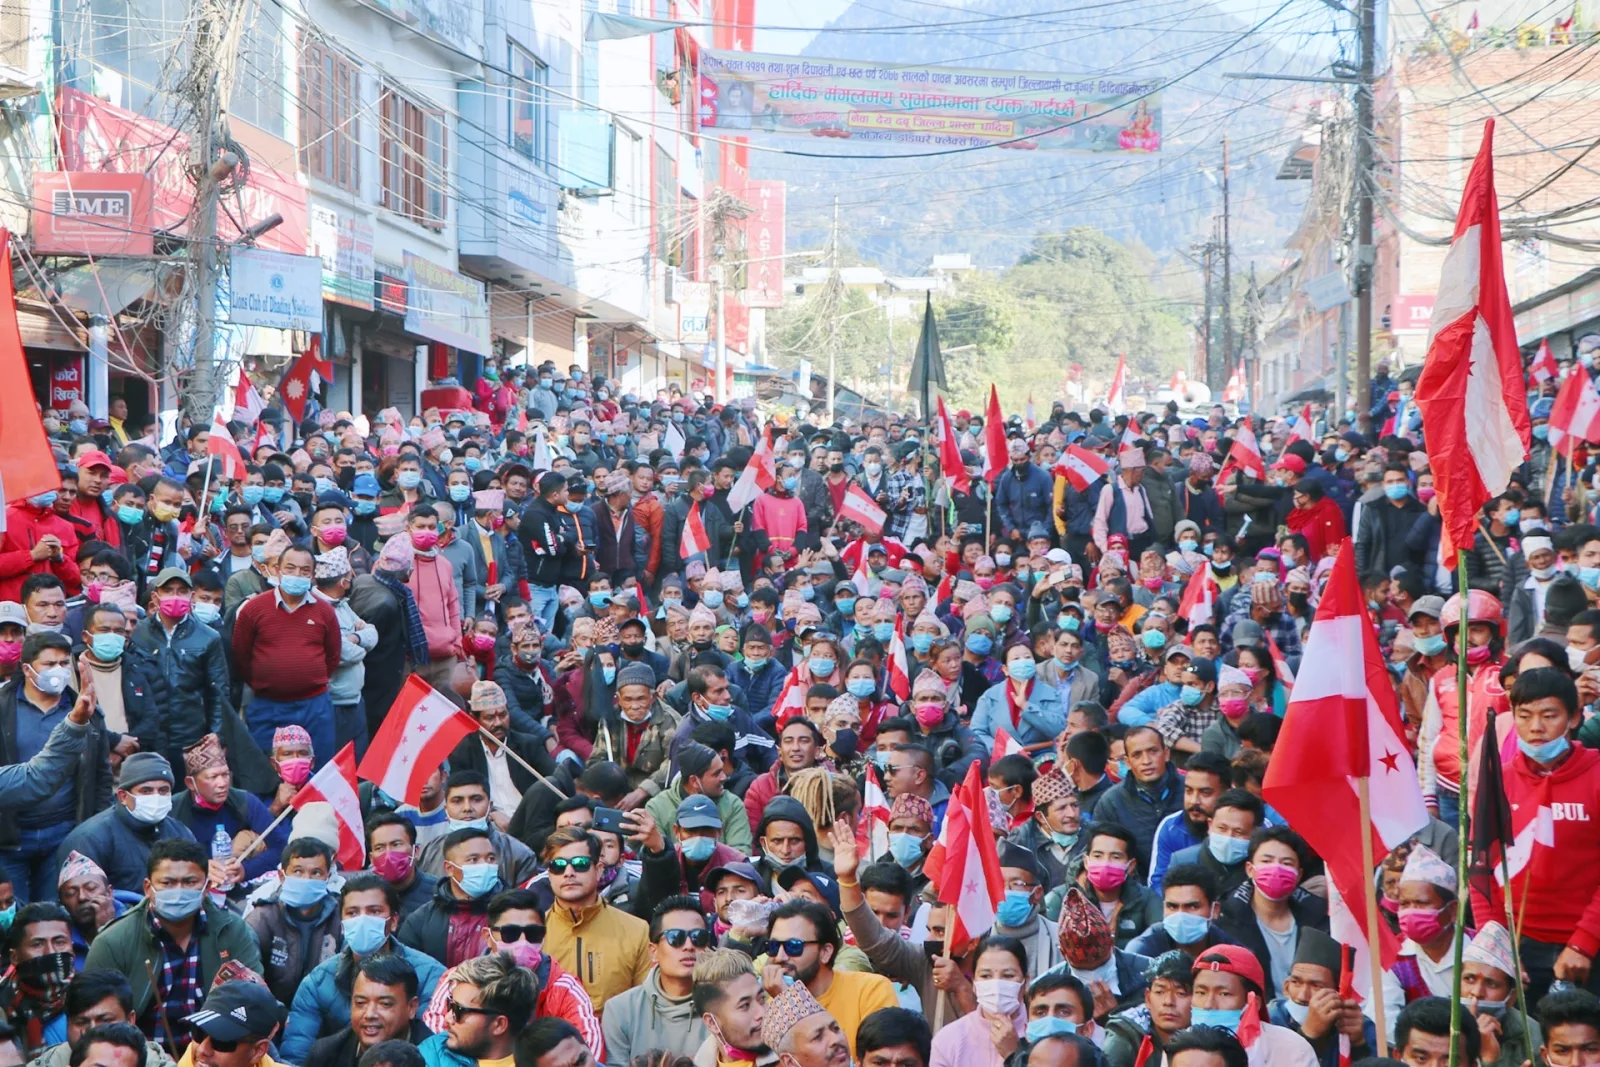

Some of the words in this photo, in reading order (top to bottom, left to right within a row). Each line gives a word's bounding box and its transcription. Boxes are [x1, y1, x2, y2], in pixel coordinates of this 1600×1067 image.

[768, 62, 784, 73] तथा
[902, 70, 929, 82] सालको
[954, 74, 988, 87] अवसरमा
[768, 79, 817, 100] हार्दिक
[824, 84, 894, 105] मंगलमय
[899, 92, 979, 111] शुभकामना
[985, 96, 1024, 113] व्यक्त
[66, 197, 124, 217] IME
[232, 291, 248, 310] Lions
[249, 293, 261, 311] Club
[262, 295, 269, 312] of
[1409, 305, 1434, 320] IM
